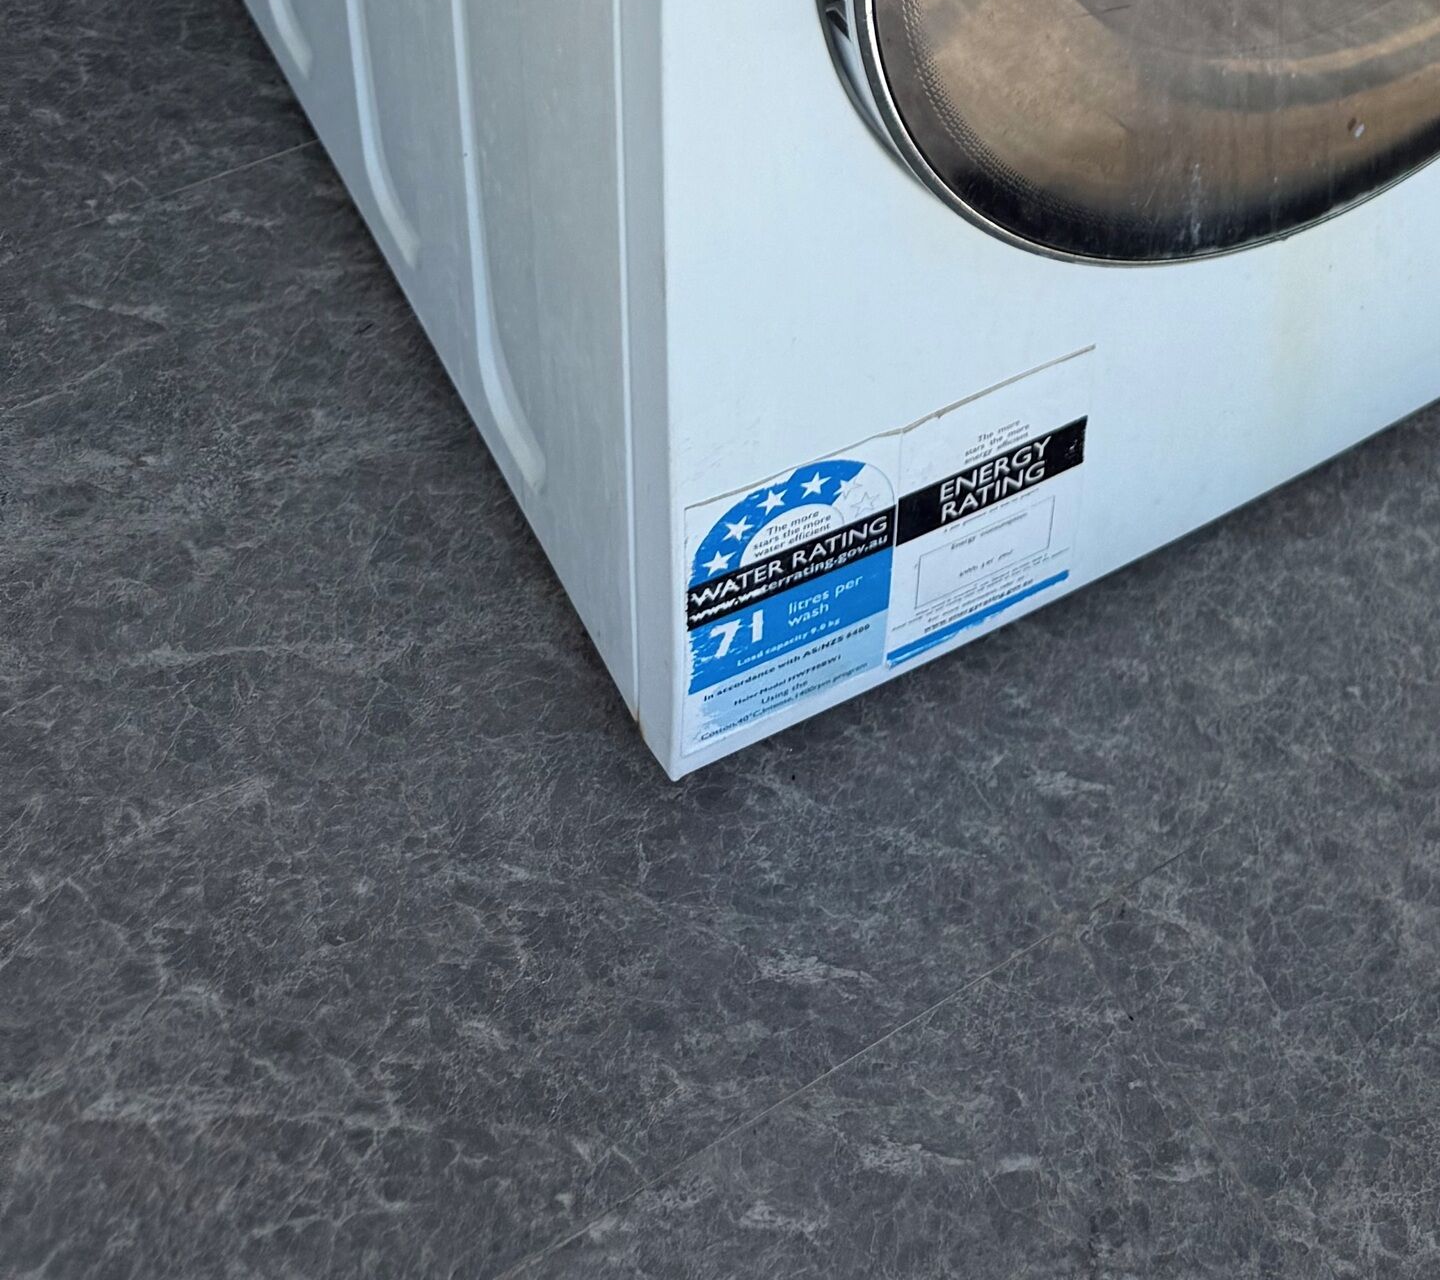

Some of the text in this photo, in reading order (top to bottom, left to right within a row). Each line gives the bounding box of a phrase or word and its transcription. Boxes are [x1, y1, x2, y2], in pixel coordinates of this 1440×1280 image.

[939, 435, 1051, 503] ENERGY
[940, 458, 1045, 524] RATING
[753, 514, 830, 550] stars the more
[754, 522, 830, 558] water efficient
[766, 510, 818, 536] The more
[689, 533, 887, 624] www.waterrating.gov.au
[690, 514, 887, 610] WATER RATING
[788, 574, 862, 615] litres per
[788, 600, 829, 628] wash
